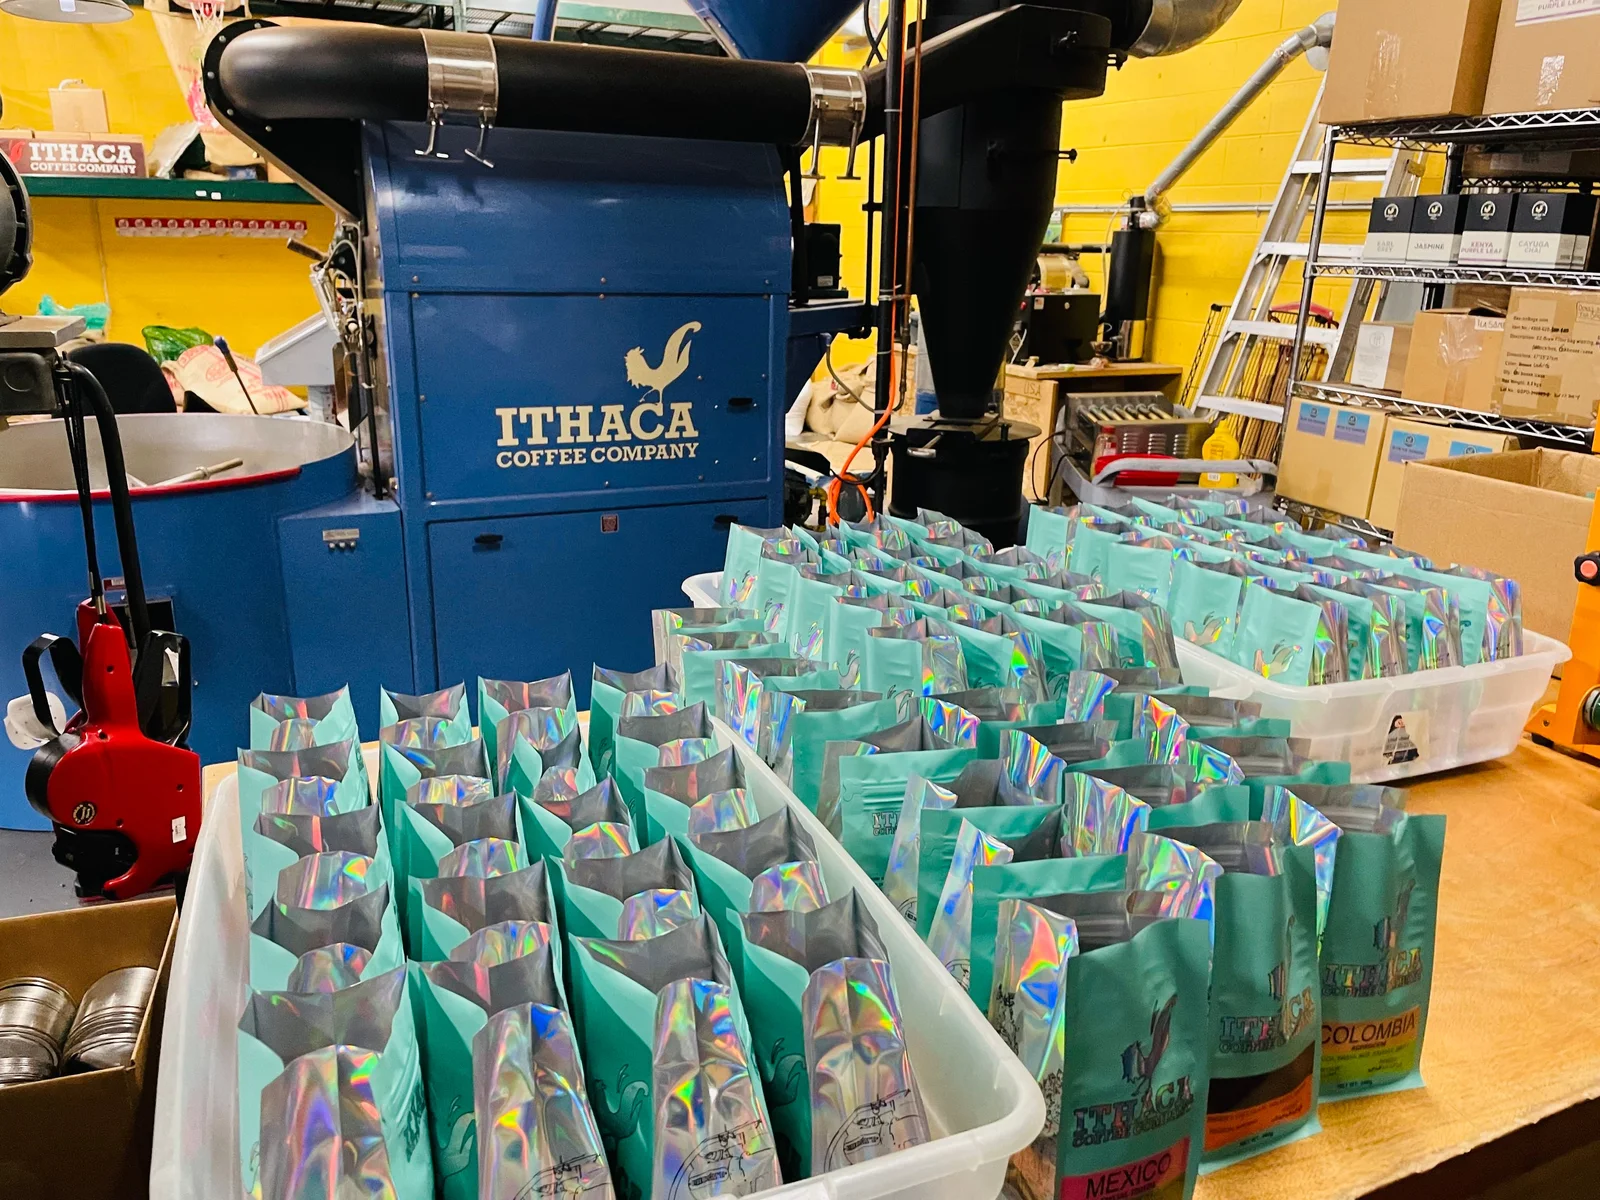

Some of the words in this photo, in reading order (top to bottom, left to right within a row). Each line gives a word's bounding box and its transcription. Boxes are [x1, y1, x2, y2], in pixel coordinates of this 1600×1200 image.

[29, 142, 137, 164] ITHACA
[30, 162, 77, 172] COFFEE
[78, 163, 137, 174] COMPANY
[1518, 240, 1550, 248] CAYUGA
[495, 402, 699, 446] ITHACA
[496, 448, 587, 468] COFFEE
[590, 443, 699, 463] COMPANY
[1321, 1012, 1416, 1045] COLOMBIA
[1072, 1075, 1194, 1134] ITHACA
[1085, 1152, 1172, 1200] MEXICO
